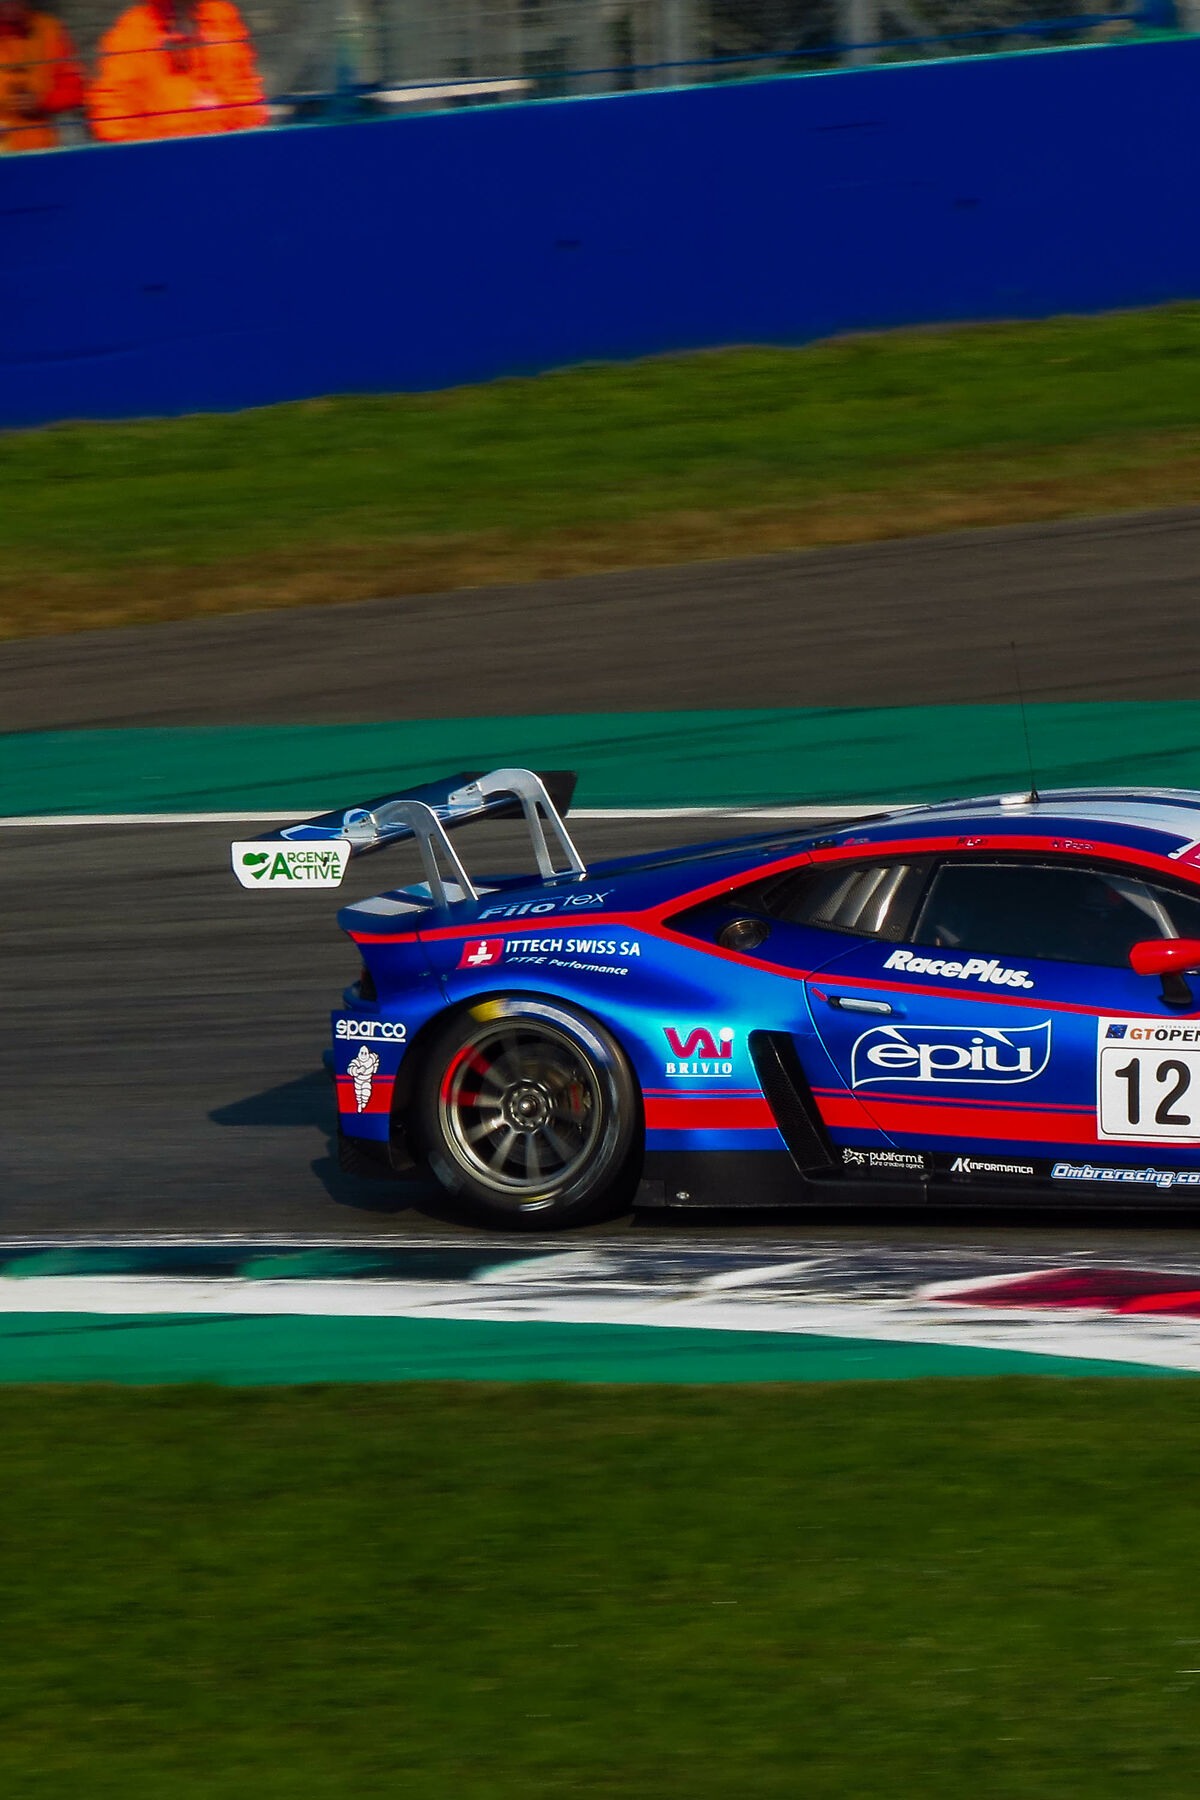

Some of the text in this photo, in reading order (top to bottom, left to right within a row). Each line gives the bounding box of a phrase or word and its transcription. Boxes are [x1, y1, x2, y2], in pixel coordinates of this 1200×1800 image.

[506, 939, 641, 956] ITTECH SWISS SA
[506, 956, 629, 976] PTFE Performance
[336, 1019, 407, 1041] sparco
[666, 1062, 733, 1074] BRIVIO
[1114, 1057, 1191, 1125] 12
